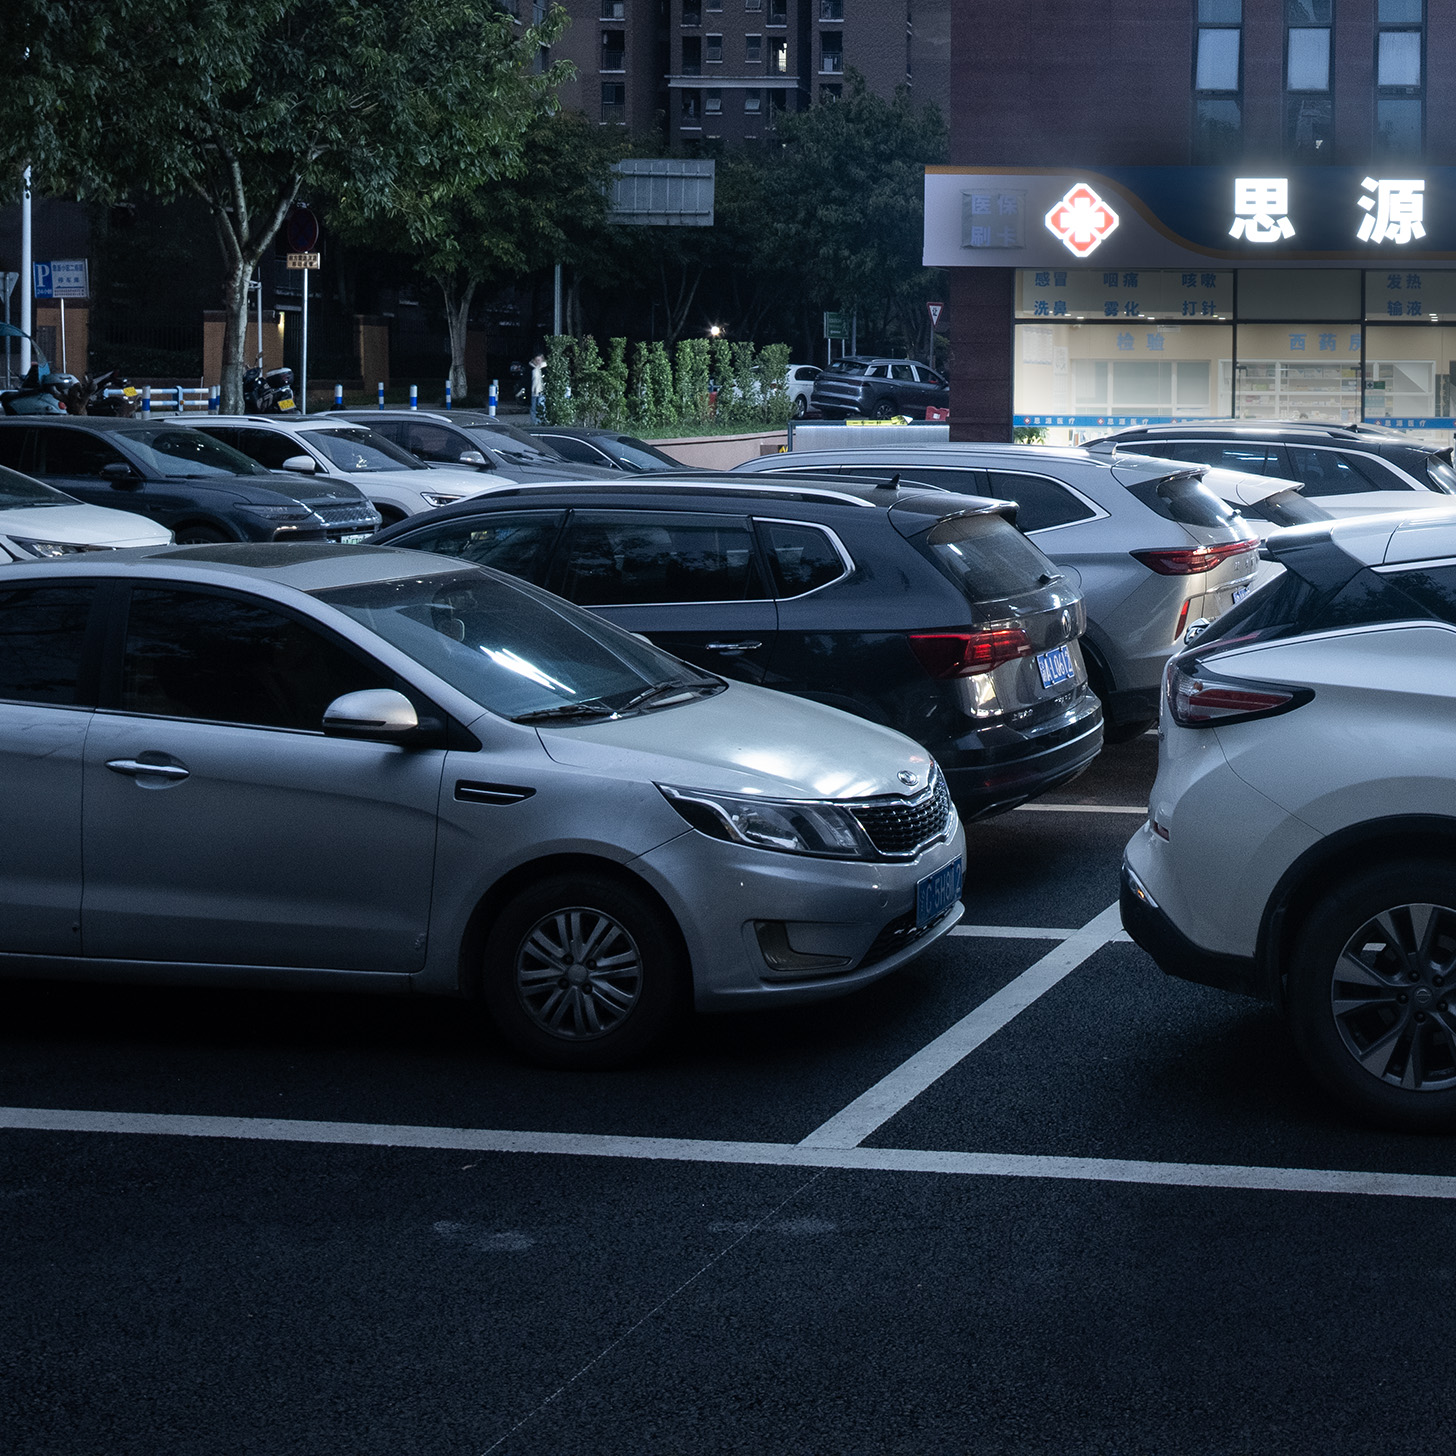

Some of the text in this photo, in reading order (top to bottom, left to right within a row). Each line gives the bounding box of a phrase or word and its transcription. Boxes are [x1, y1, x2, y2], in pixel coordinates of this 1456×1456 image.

[972, 194, 1018, 216] 医保
[971, 226, 1017, 247] 刷卡
[36, 264, 50, 287] P
[1034, 272, 1217, 288] 感冒 咽痛 咳嗽
[1386, 273, 1422, 290] 发热
[1034, 300, 1217, 317] 洗鼻 雾化 打针
[1386, 300, 1422, 318] 输液
[1116, 332, 1165, 352] 检验
